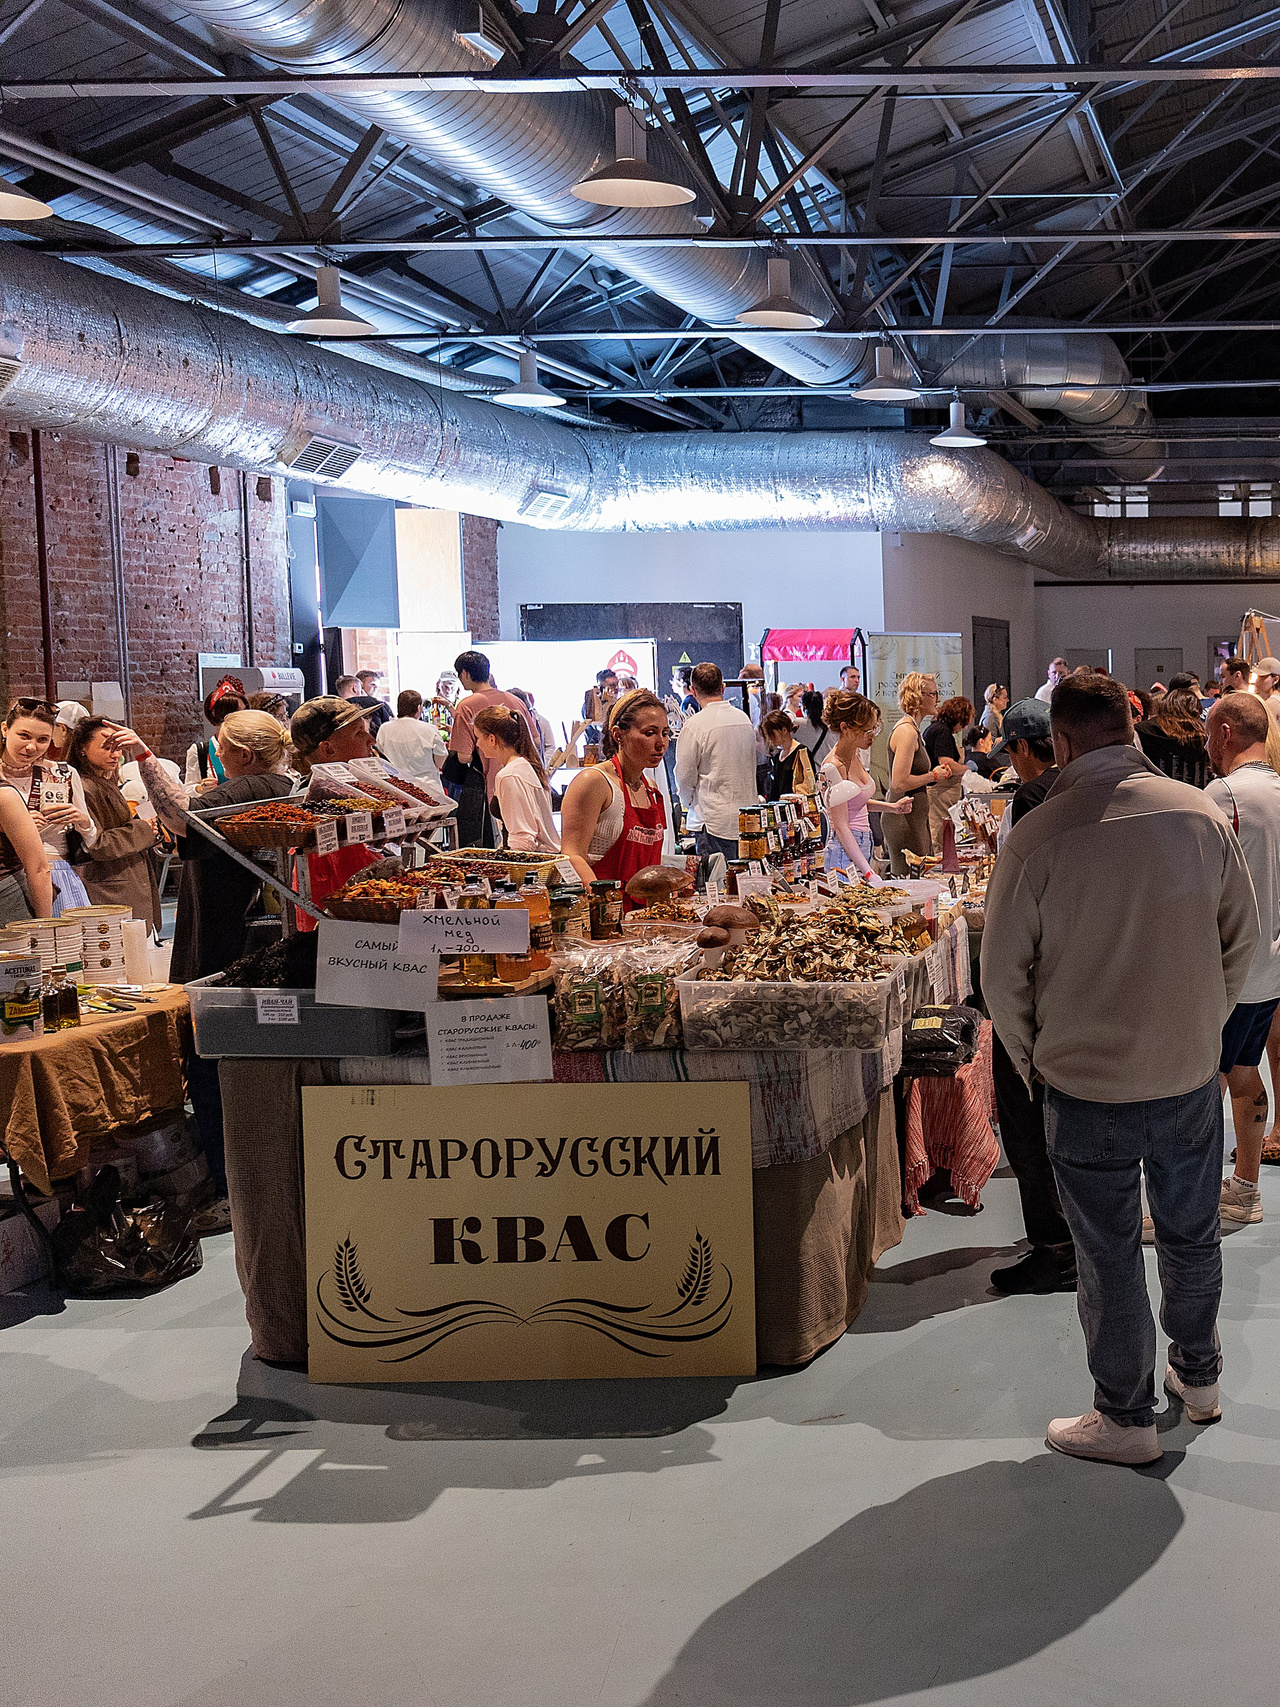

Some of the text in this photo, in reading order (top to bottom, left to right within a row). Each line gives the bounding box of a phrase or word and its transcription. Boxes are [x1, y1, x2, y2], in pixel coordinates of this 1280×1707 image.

[355, 939, 399, 952] САМЫЙ
[328, 956, 428, 975] ВКУСНЫЙ КВАС
[469, 1013, 511, 1022] ПРОДАЖЕ
[437, 1023, 538, 1036] СТАРОРУССКИЕ КВАСЫ:
[428, 1211, 652, 1265] КВАС
